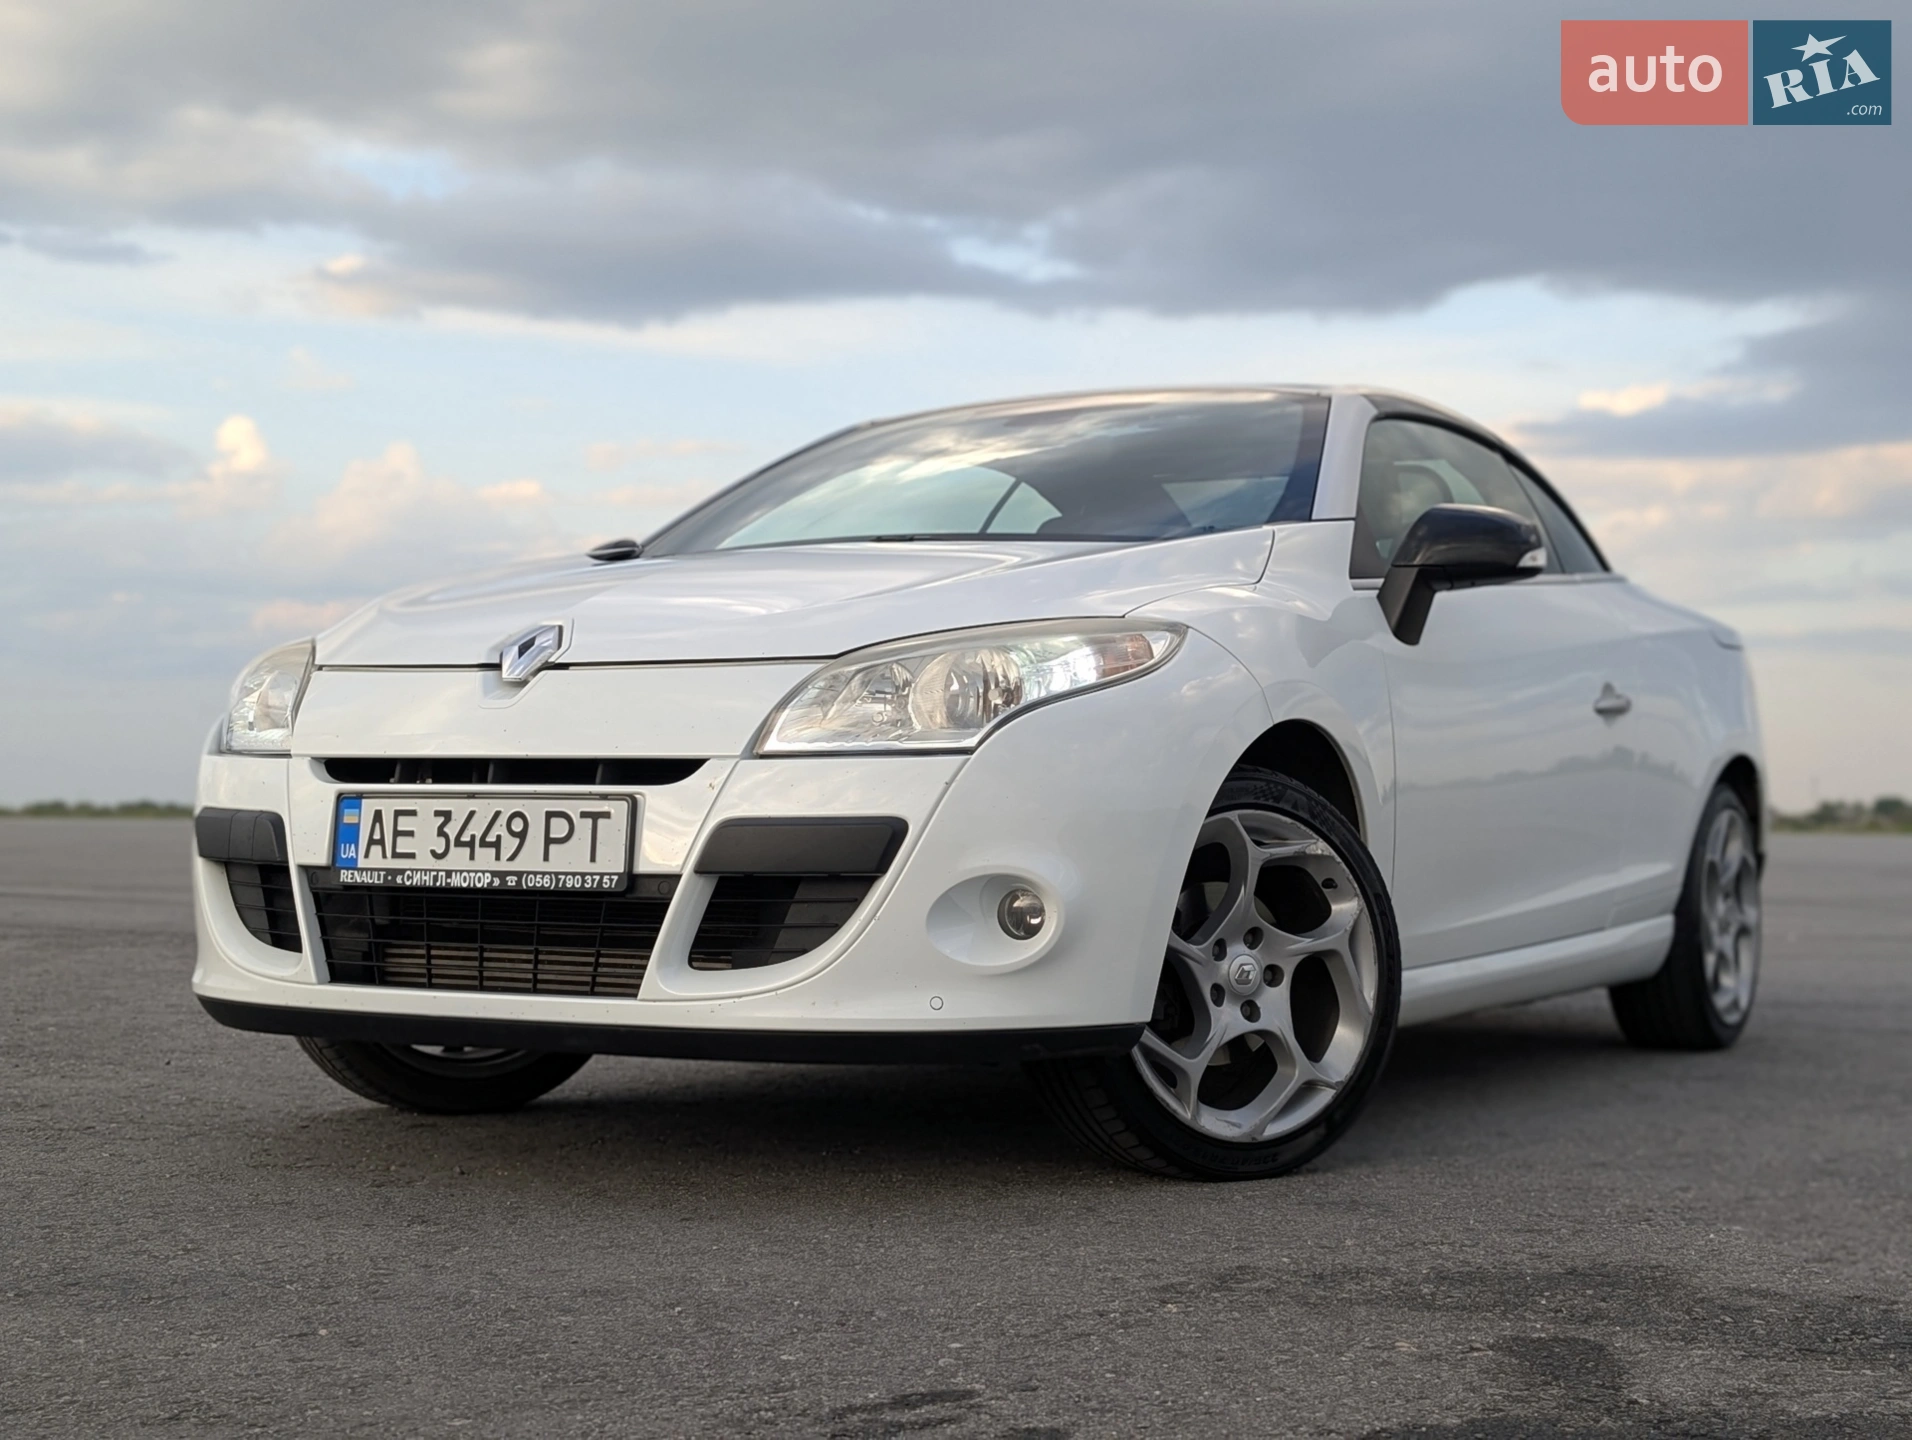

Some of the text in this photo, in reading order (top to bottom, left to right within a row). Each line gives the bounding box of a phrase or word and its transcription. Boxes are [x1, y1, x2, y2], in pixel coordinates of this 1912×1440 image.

[364, 809, 612, 862] AE 3449 PT
[340, 843, 357, 859] UA
[340, 869, 386, 884] RENAULT
